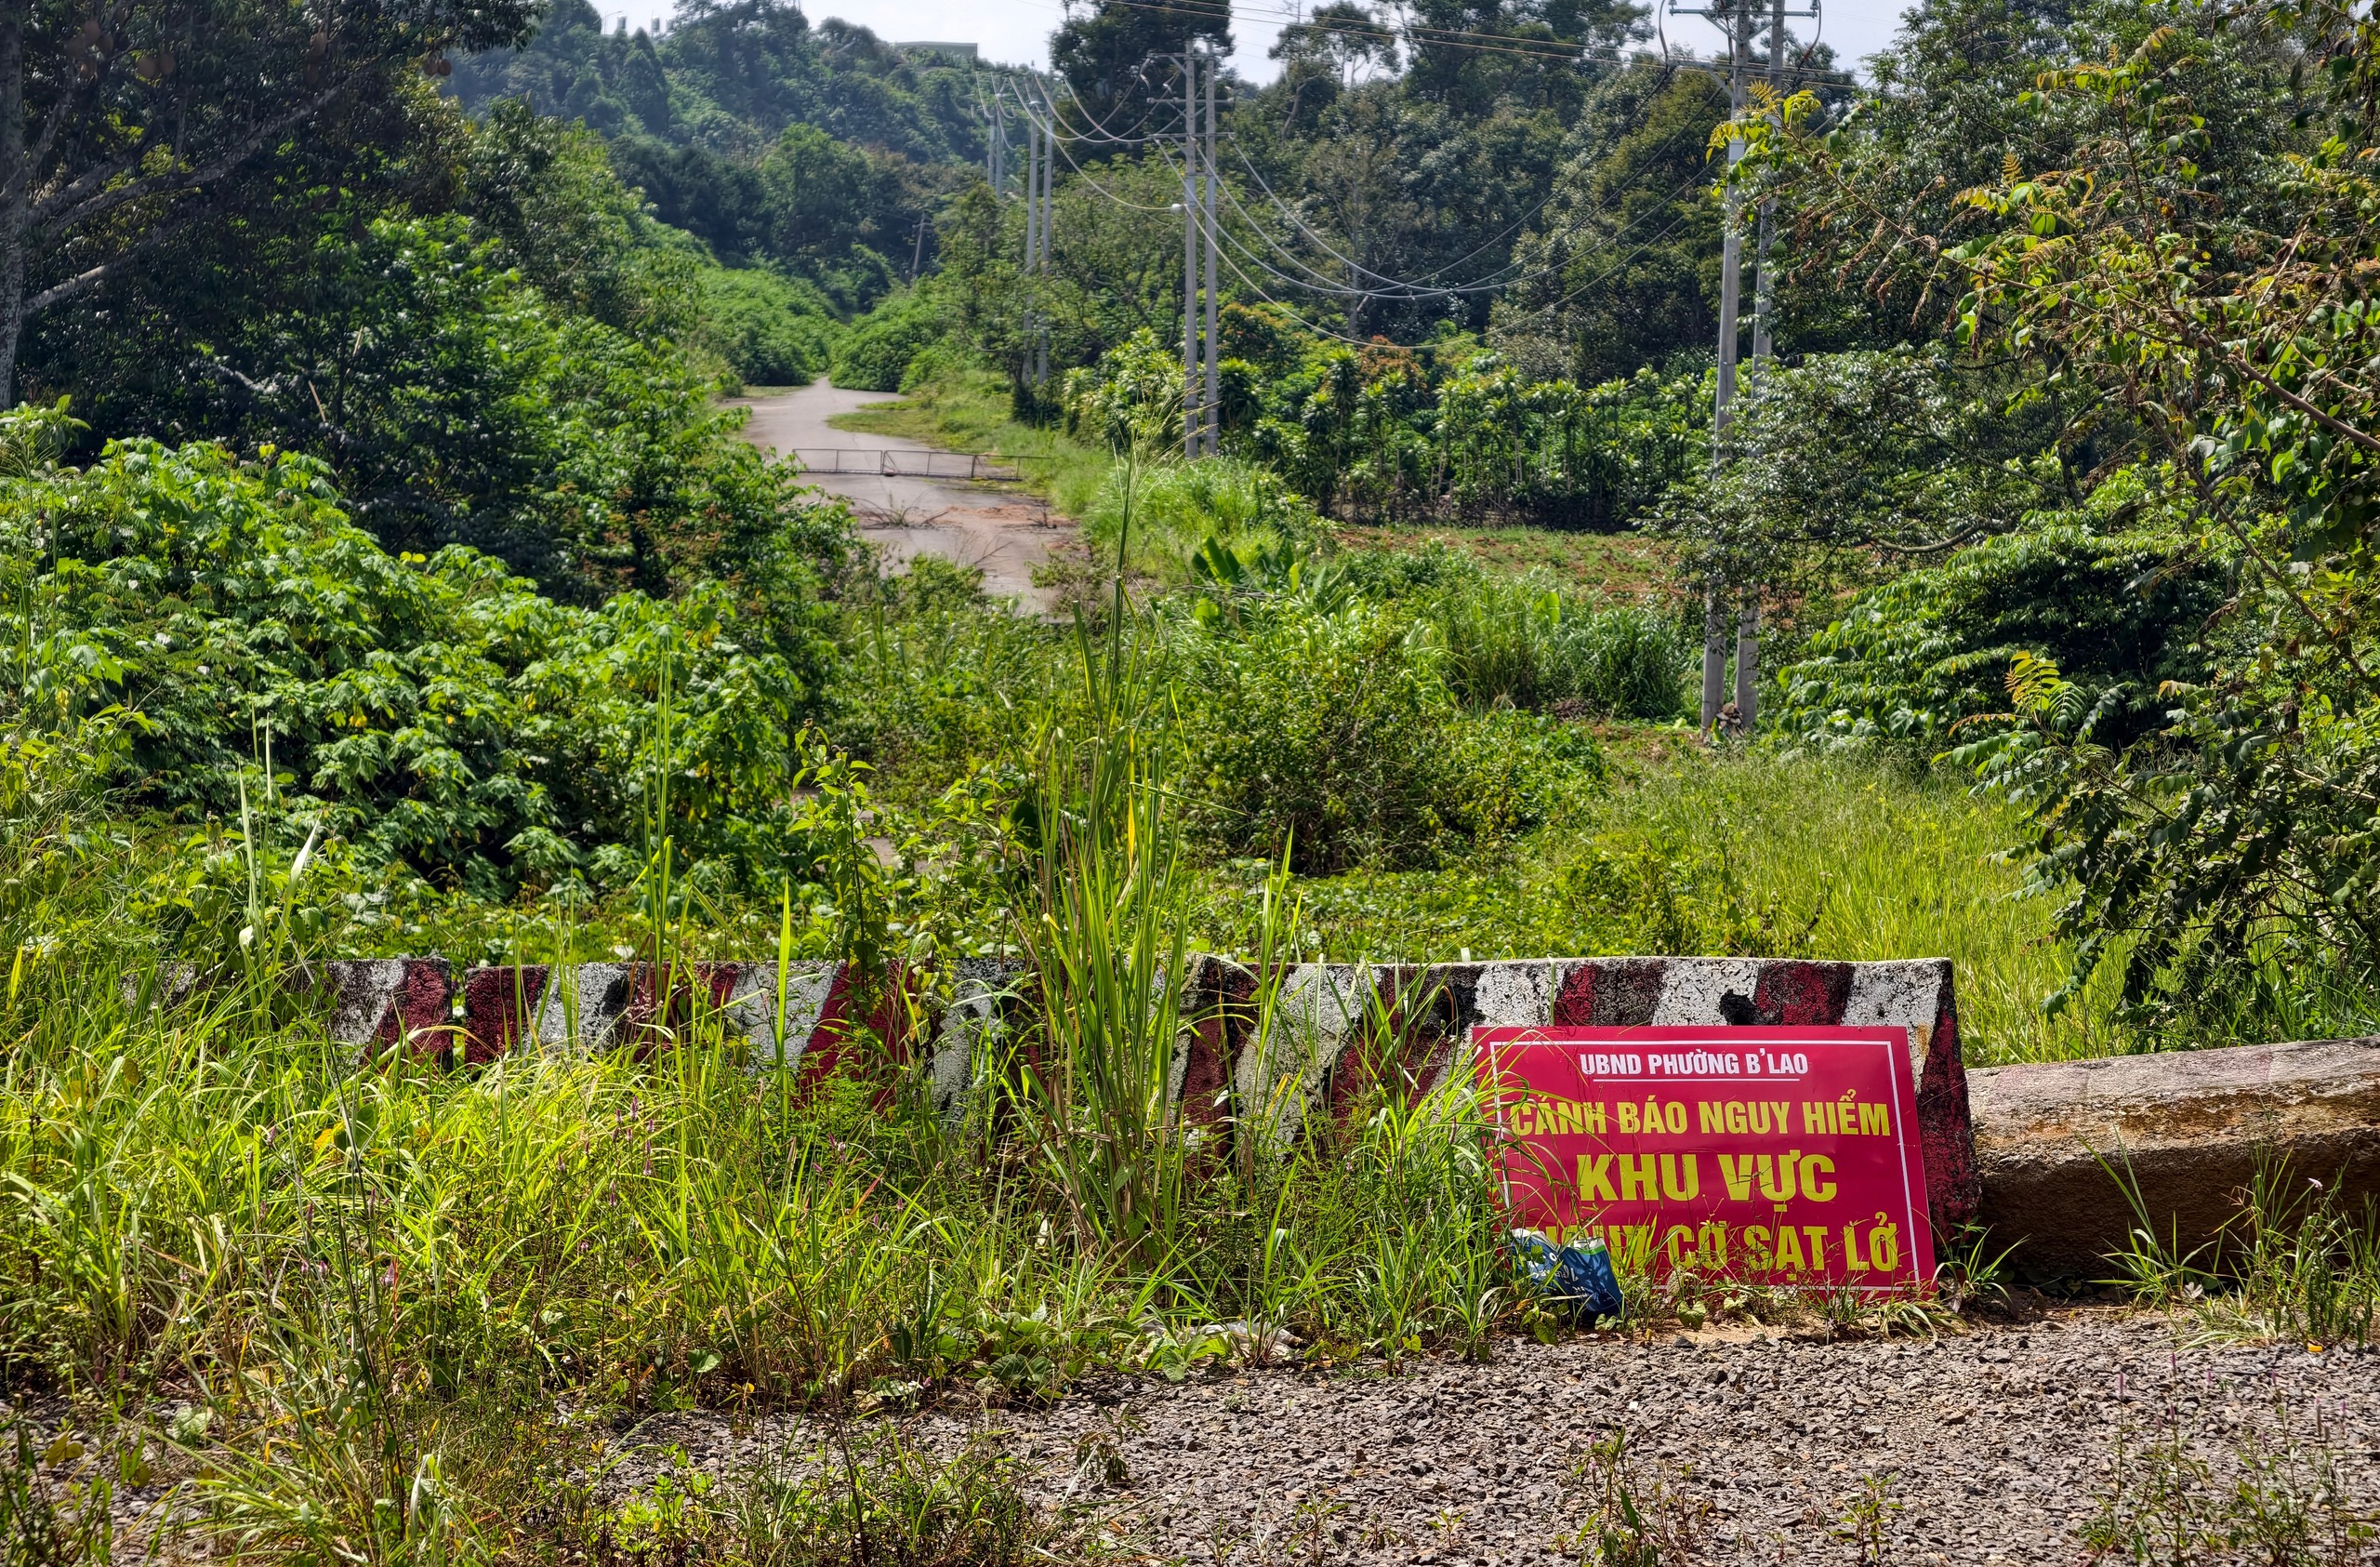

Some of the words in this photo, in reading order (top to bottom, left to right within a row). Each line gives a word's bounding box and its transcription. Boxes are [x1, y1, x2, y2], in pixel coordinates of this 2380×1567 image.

[1580, 1053, 1642, 1075] UBND
[1647, 1048, 1740, 1075] PHƯỜNG
[1616, 1095, 1688, 1135] BÁO
[1698, 1100, 1791, 1135] NGUY
[1802, 1088, 1891, 1136] HIỂM
[1576, 1153, 1699, 1202] KHU
[1717, 1149, 1838, 1213] VỰC
[1743, 1224, 1829, 1281] SẠT
[1843, 1211, 1899, 1272] LỞ
